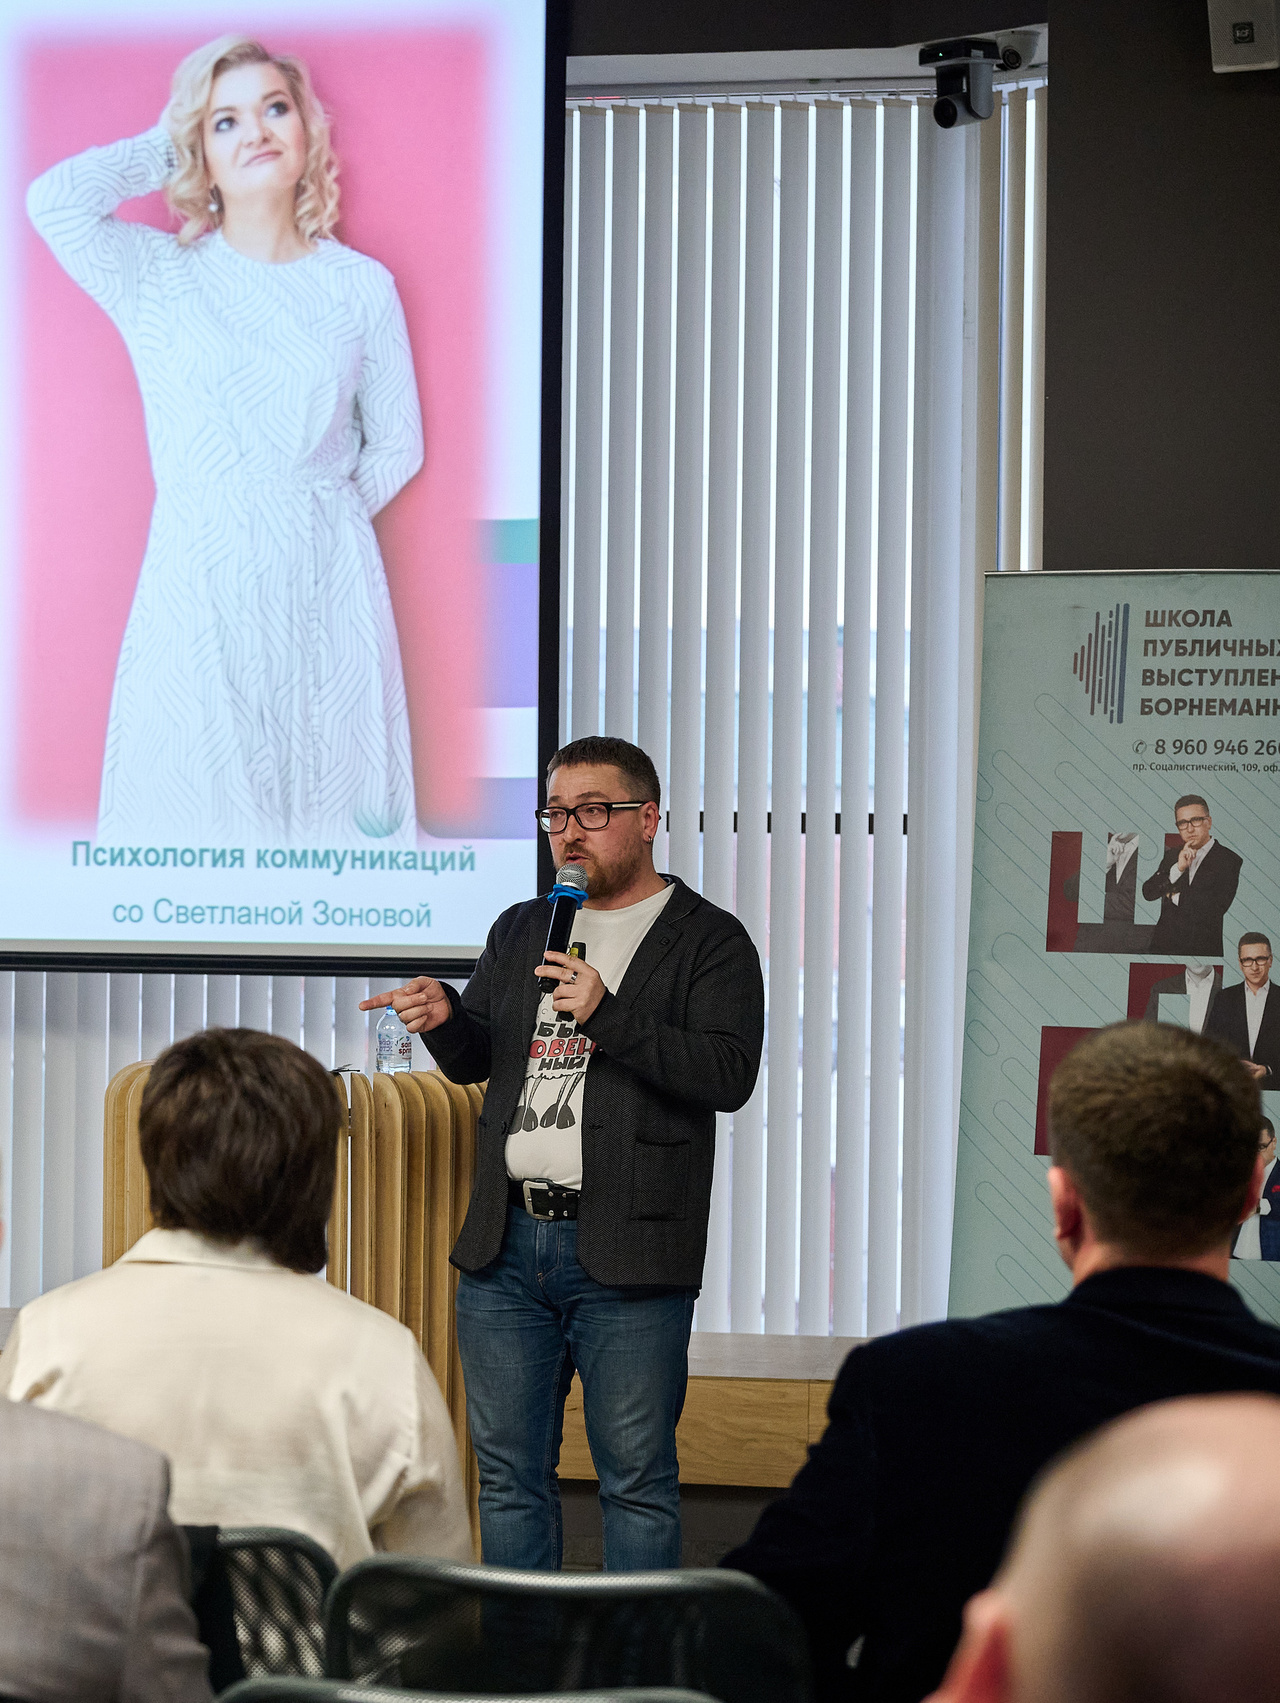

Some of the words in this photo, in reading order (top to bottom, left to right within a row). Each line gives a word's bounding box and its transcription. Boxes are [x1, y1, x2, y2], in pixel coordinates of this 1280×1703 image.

[1145, 610, 1232, 627] ШКОЛА
[1144, 639, 1280, 657] ПУБЛИЧНЫ
[1155, 739, 1165, 754] 8
[1173, 739, 1207, 755] 960
[1214, 740, 1248, 755] 946
[1255, 740, 1280, 755] 26
[1133, 764, 1147, 773] пр.
[1150, 762, 1238, 773] Соцалистический,
[1242, 763, 1260, 772] 109,
[1263, 763, 1280, 774] оф.
[73, 841, 244, 870] Психология
[257, 842, 474, 875] коммуникаций
[113, 905, 143, 922] со
[154, 898, 302, 925] Светланой
[313, 900, 430, 927] Зоновой
